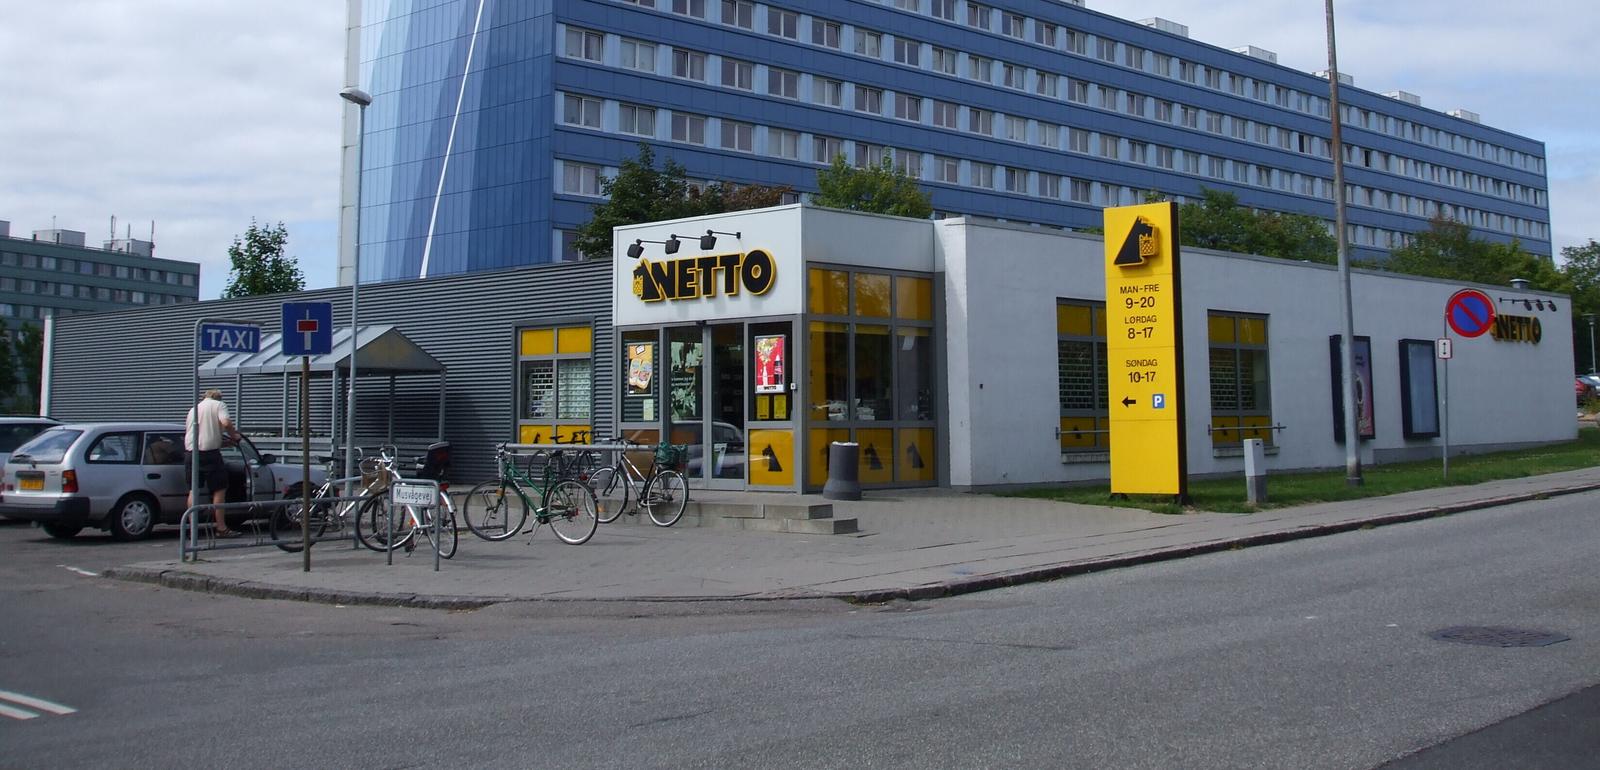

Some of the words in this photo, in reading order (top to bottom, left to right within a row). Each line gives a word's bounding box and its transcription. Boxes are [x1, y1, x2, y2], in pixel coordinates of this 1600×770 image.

[641, 249, 776, 301] NETTO
[1120, 284, 1160, 294] MAN-FRE
[1125, 296, 1155, 309] 9-20
[1124, 315, 1157, 325] LØRDAG
[1127, 327, 1154, 340] 8-17
[1496, 314, 1542, 344] NETTO
[207, 328, 253, 350] TAXI
[1126, 359, 1158, 368] SØNDAG
[1128, 371, 1156, 383] 10-17
[1154, 395, 1162, 408] P
[396, 487, 432, 505] Musvågevej
